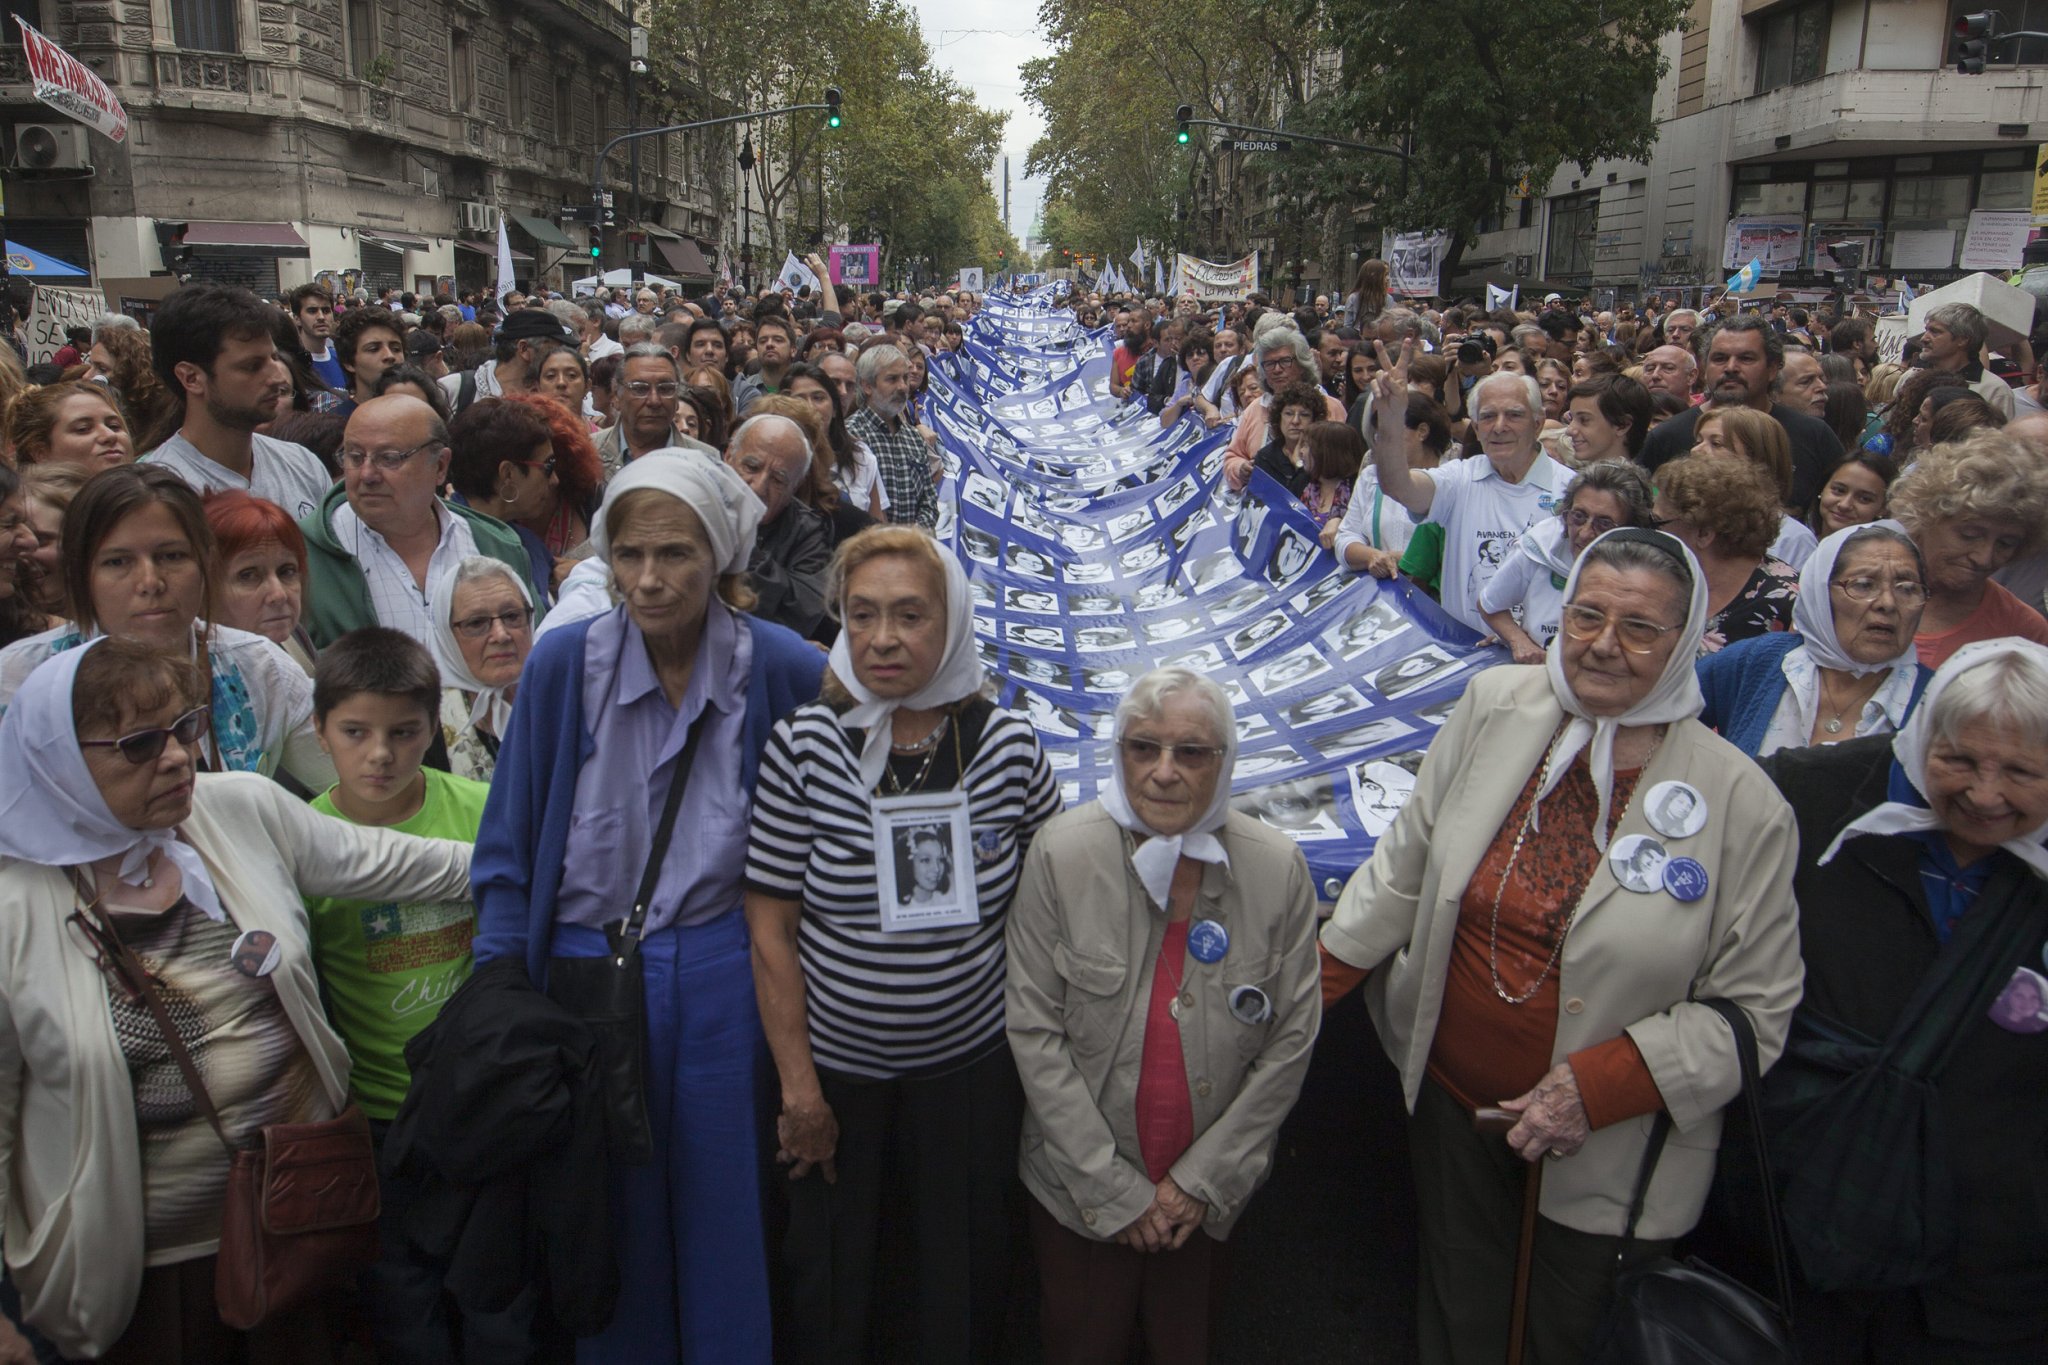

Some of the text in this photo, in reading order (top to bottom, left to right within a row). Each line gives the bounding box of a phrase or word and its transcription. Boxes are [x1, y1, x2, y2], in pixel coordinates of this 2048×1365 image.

[1233, 141, 1278, 151] PIEDRAS
[35, 320, 60, 346] SE
[1476, 530, 1516, 539] AVANCEN
